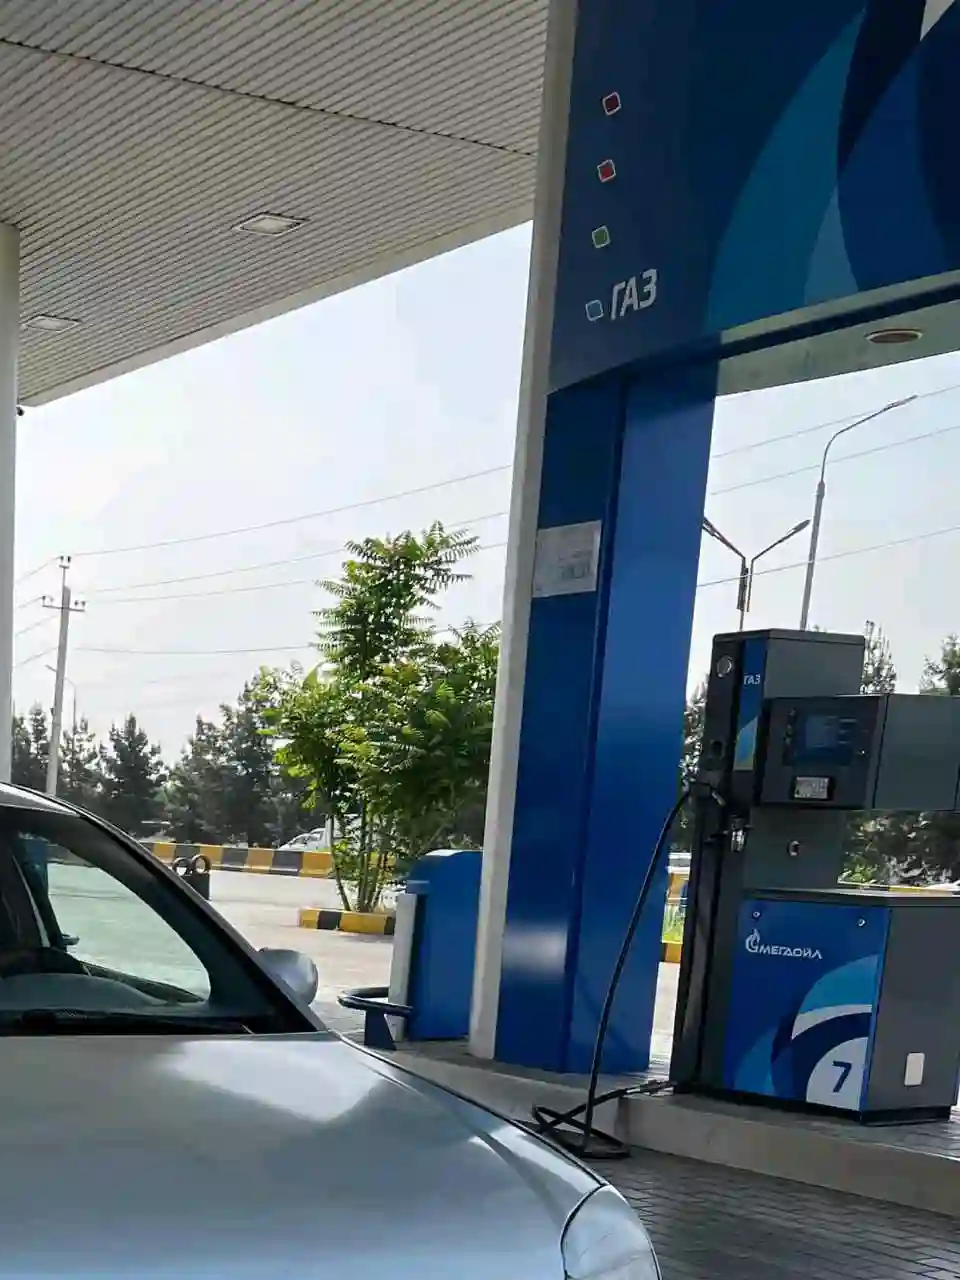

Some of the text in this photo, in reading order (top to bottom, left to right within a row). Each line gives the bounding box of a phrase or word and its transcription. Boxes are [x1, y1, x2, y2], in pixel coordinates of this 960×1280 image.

[611, 268, 658, 321] ГАЗ
[743, 673, 761, 685] ГАЗ
[832, 1060, 852, 1093] 7
